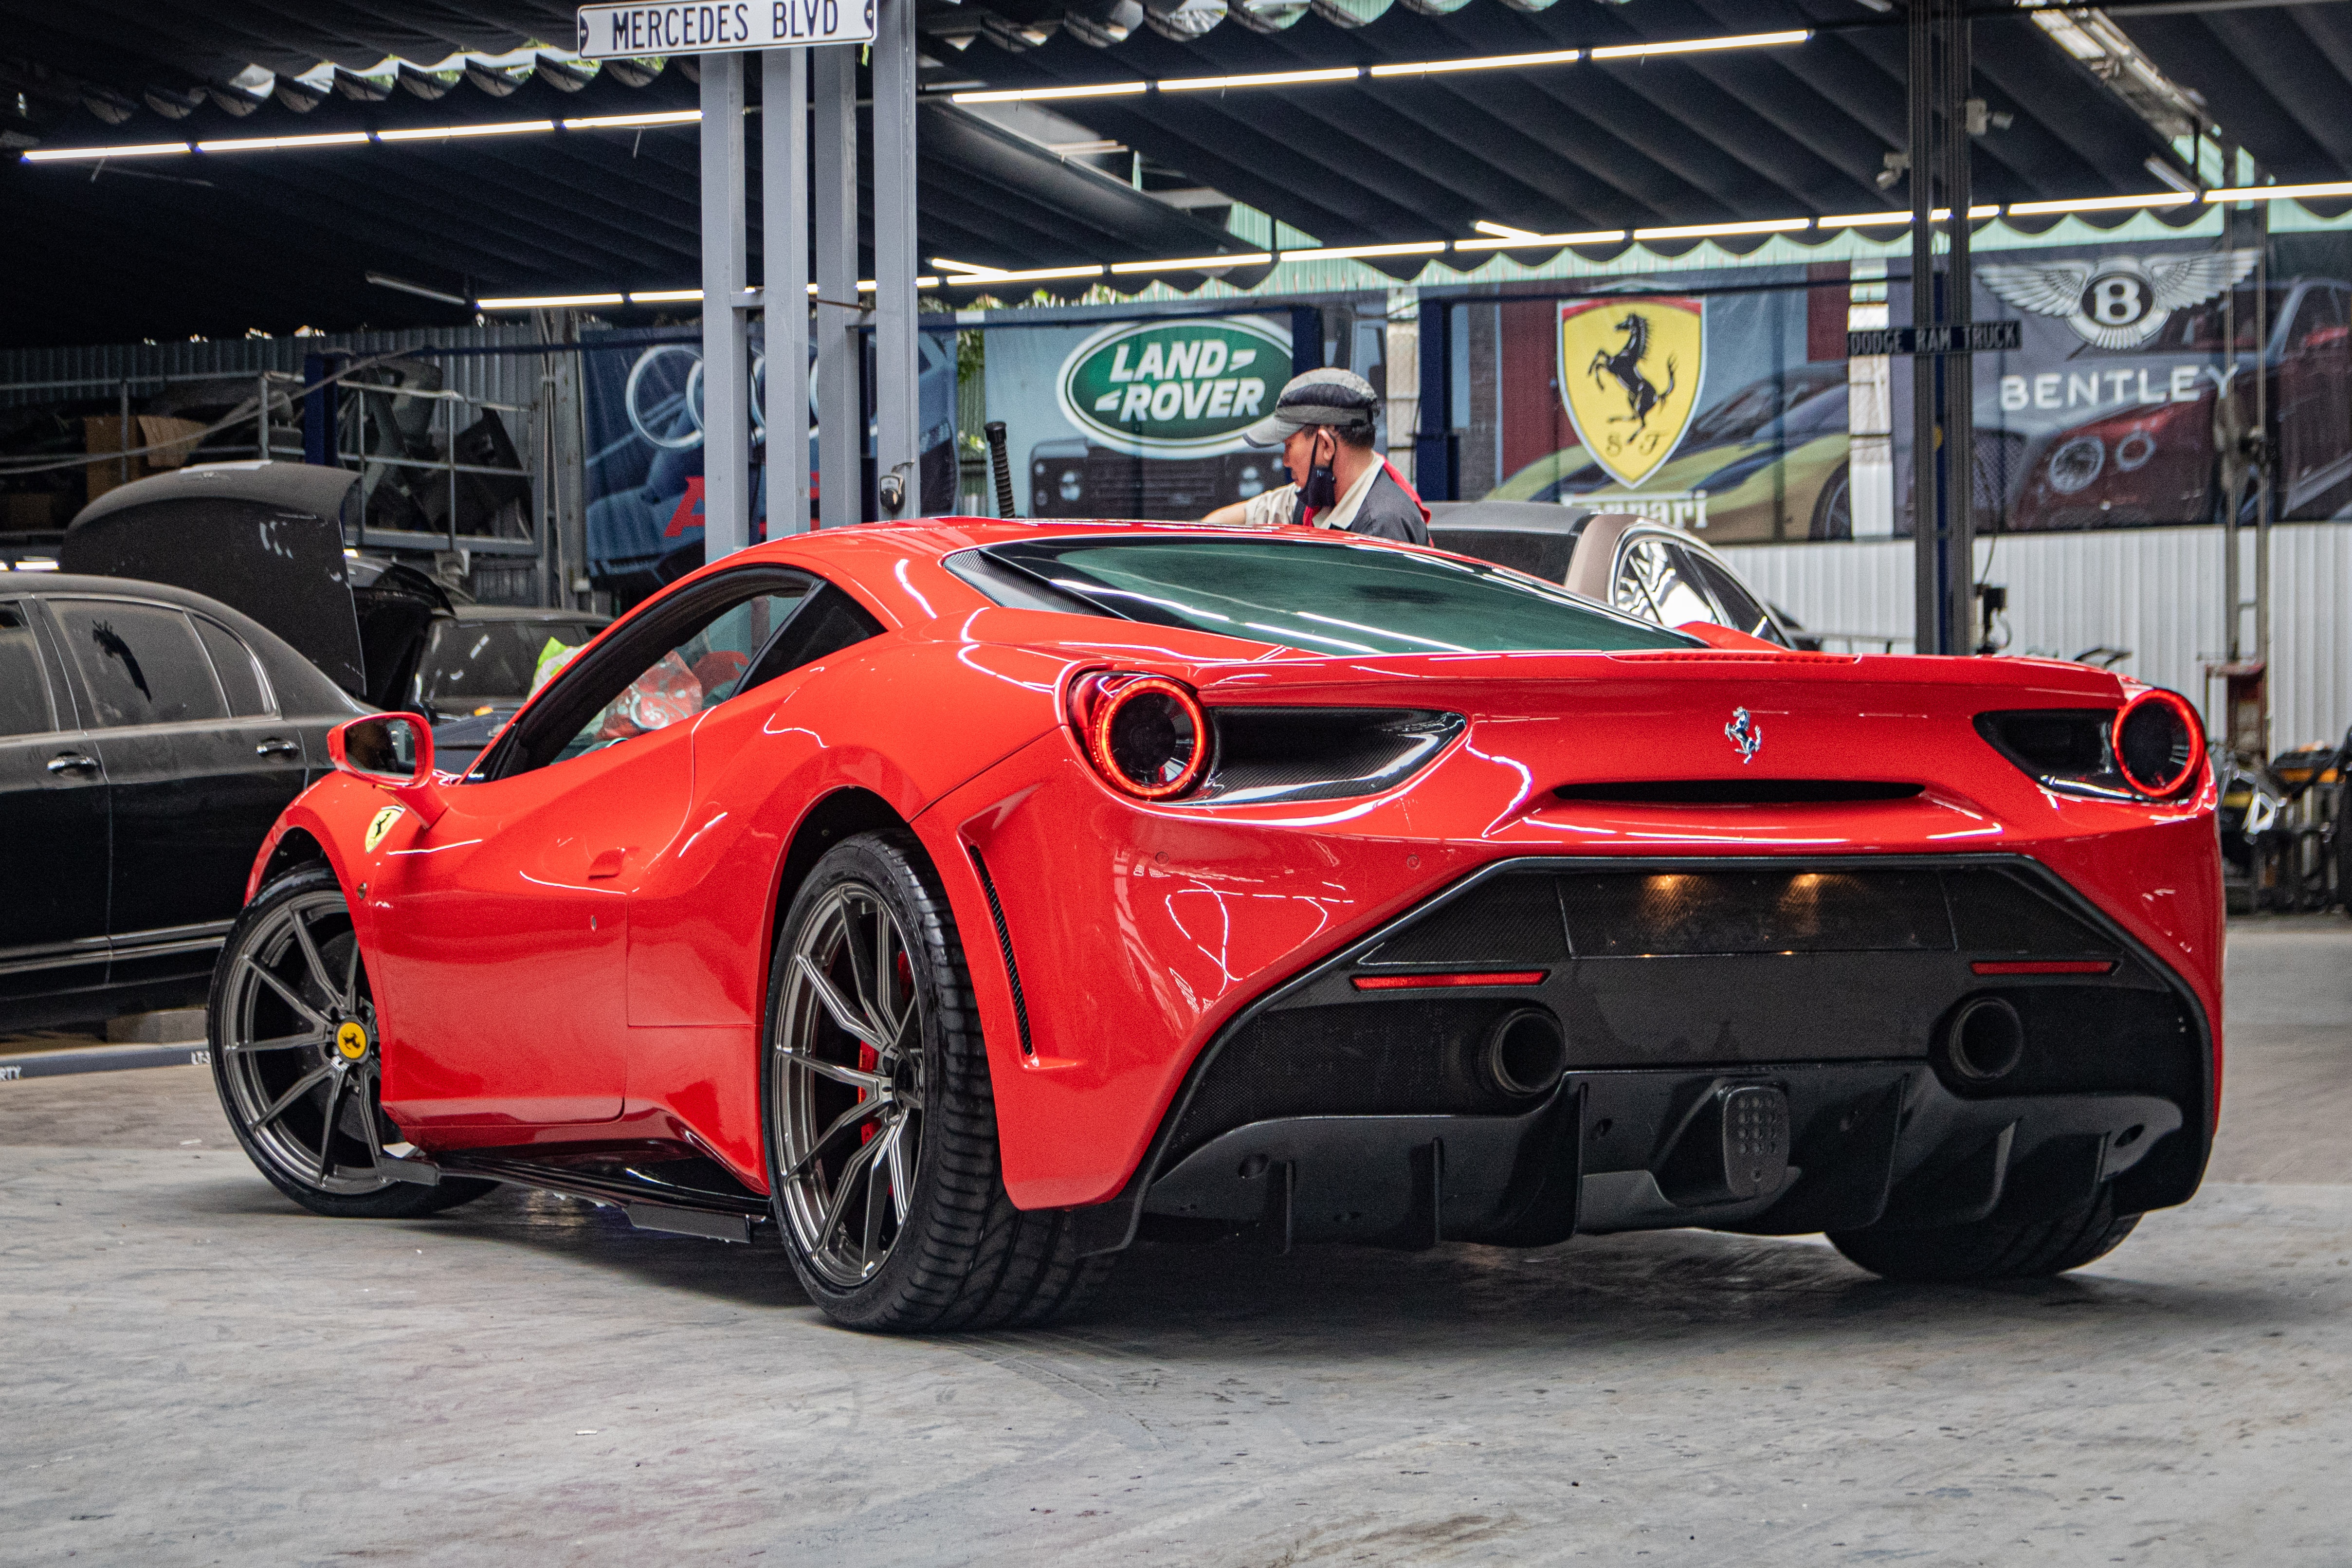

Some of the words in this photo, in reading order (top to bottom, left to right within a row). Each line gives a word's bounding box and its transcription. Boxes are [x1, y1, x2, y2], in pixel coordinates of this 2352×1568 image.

[612, 3, 749, 50] MERCEDES
[772, 0, 838, 39] BLVD
[2095, 276, 2141, 326] B
[1110, 339, 1228, 383] LAND
[1850, 329, 1903, 355] DODGE
[1915, 327, 1952, 352] RAM
[1963, 323, 2016, 350] TRUCK
[1120, 377, 1265, 422] ROVER
[2000, 364, 2239, 412] BENTLEY
